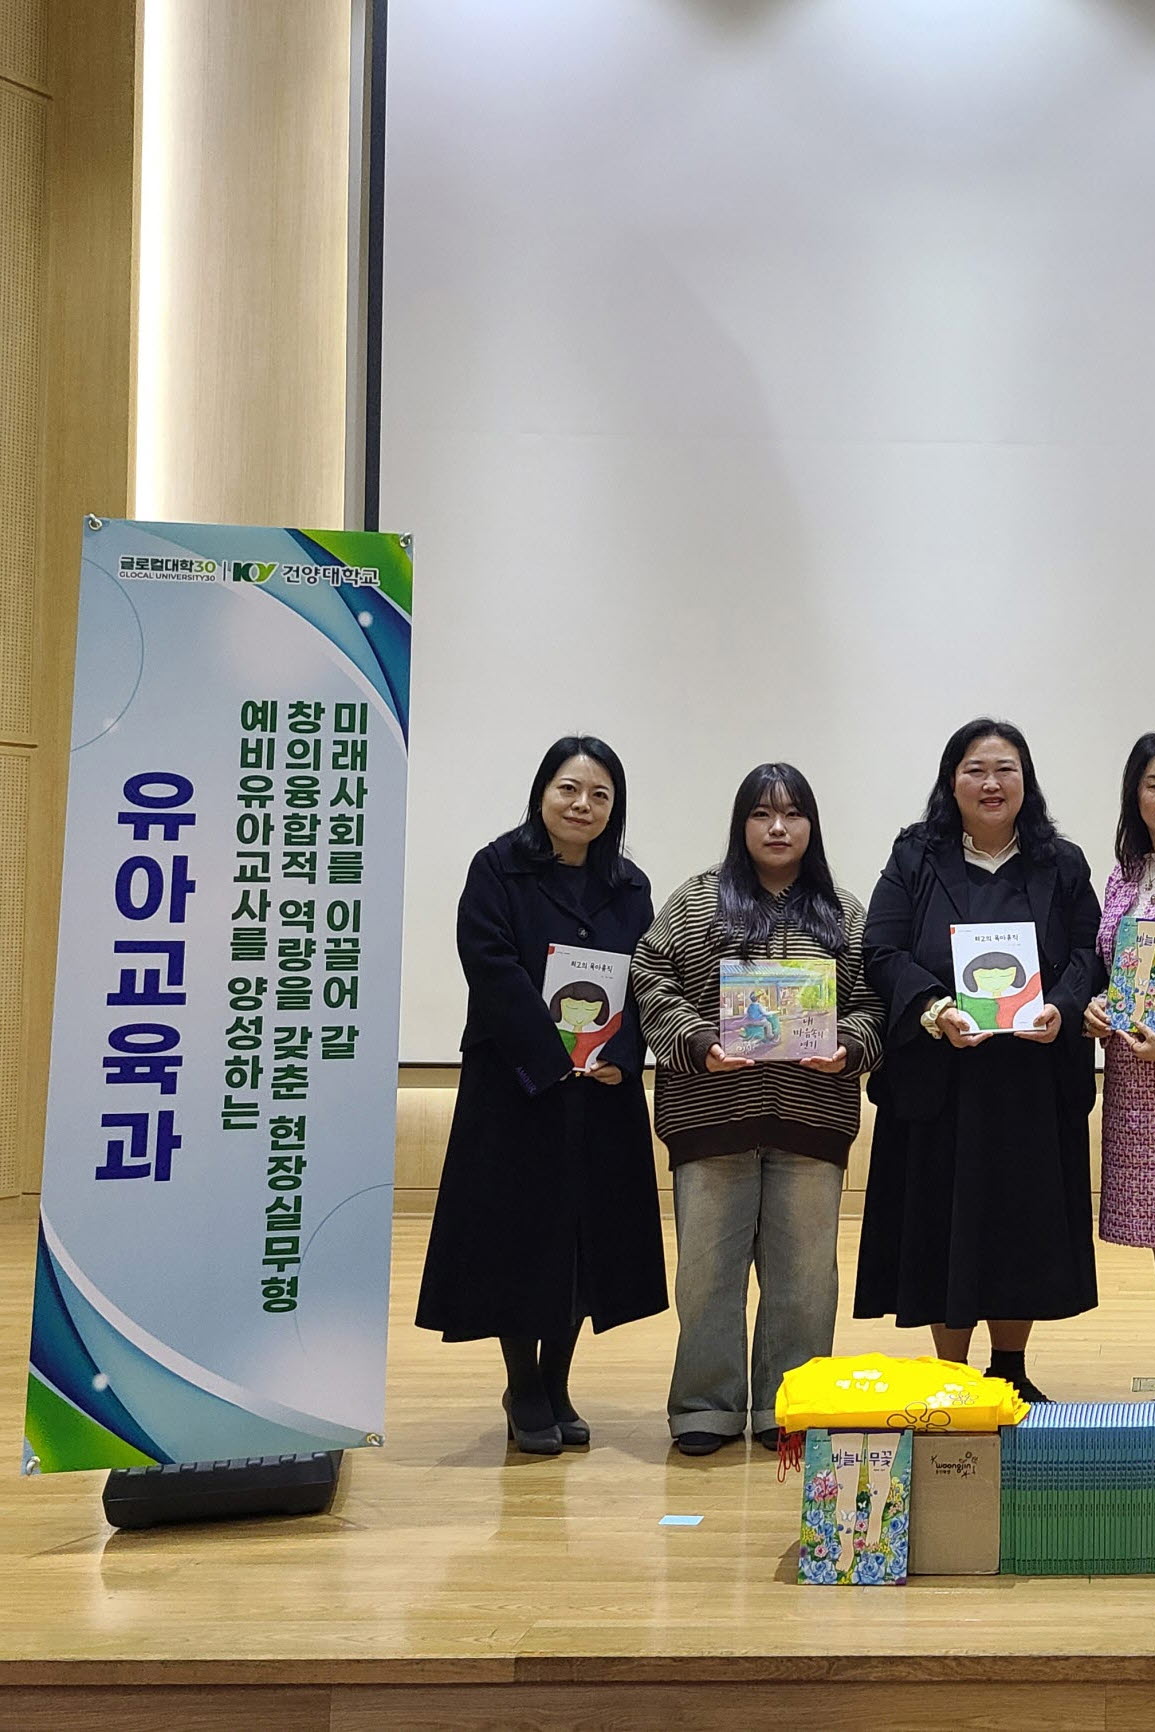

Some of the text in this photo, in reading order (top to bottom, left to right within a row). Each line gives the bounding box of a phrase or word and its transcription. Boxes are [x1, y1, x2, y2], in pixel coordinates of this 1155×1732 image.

[119, 556, 217, 574] 글로컬대학30
[119, 571, 216, 583] GLOCAL UNIVERSITY30
[282, 564, 380, 587] 건양대학교
[95, 771, 197, 1181] 유아교육과
[220, 700, 278, 1130] 예비유아교사를 양성하는
[320, 702, 369, 1060] 미래사회를 이끌어 갈
[570, 960, 613, 973] 최고의 육아휴직
[260, 700, 325, 1314] 창의융합적 역량을 갖춘 현장실무형
